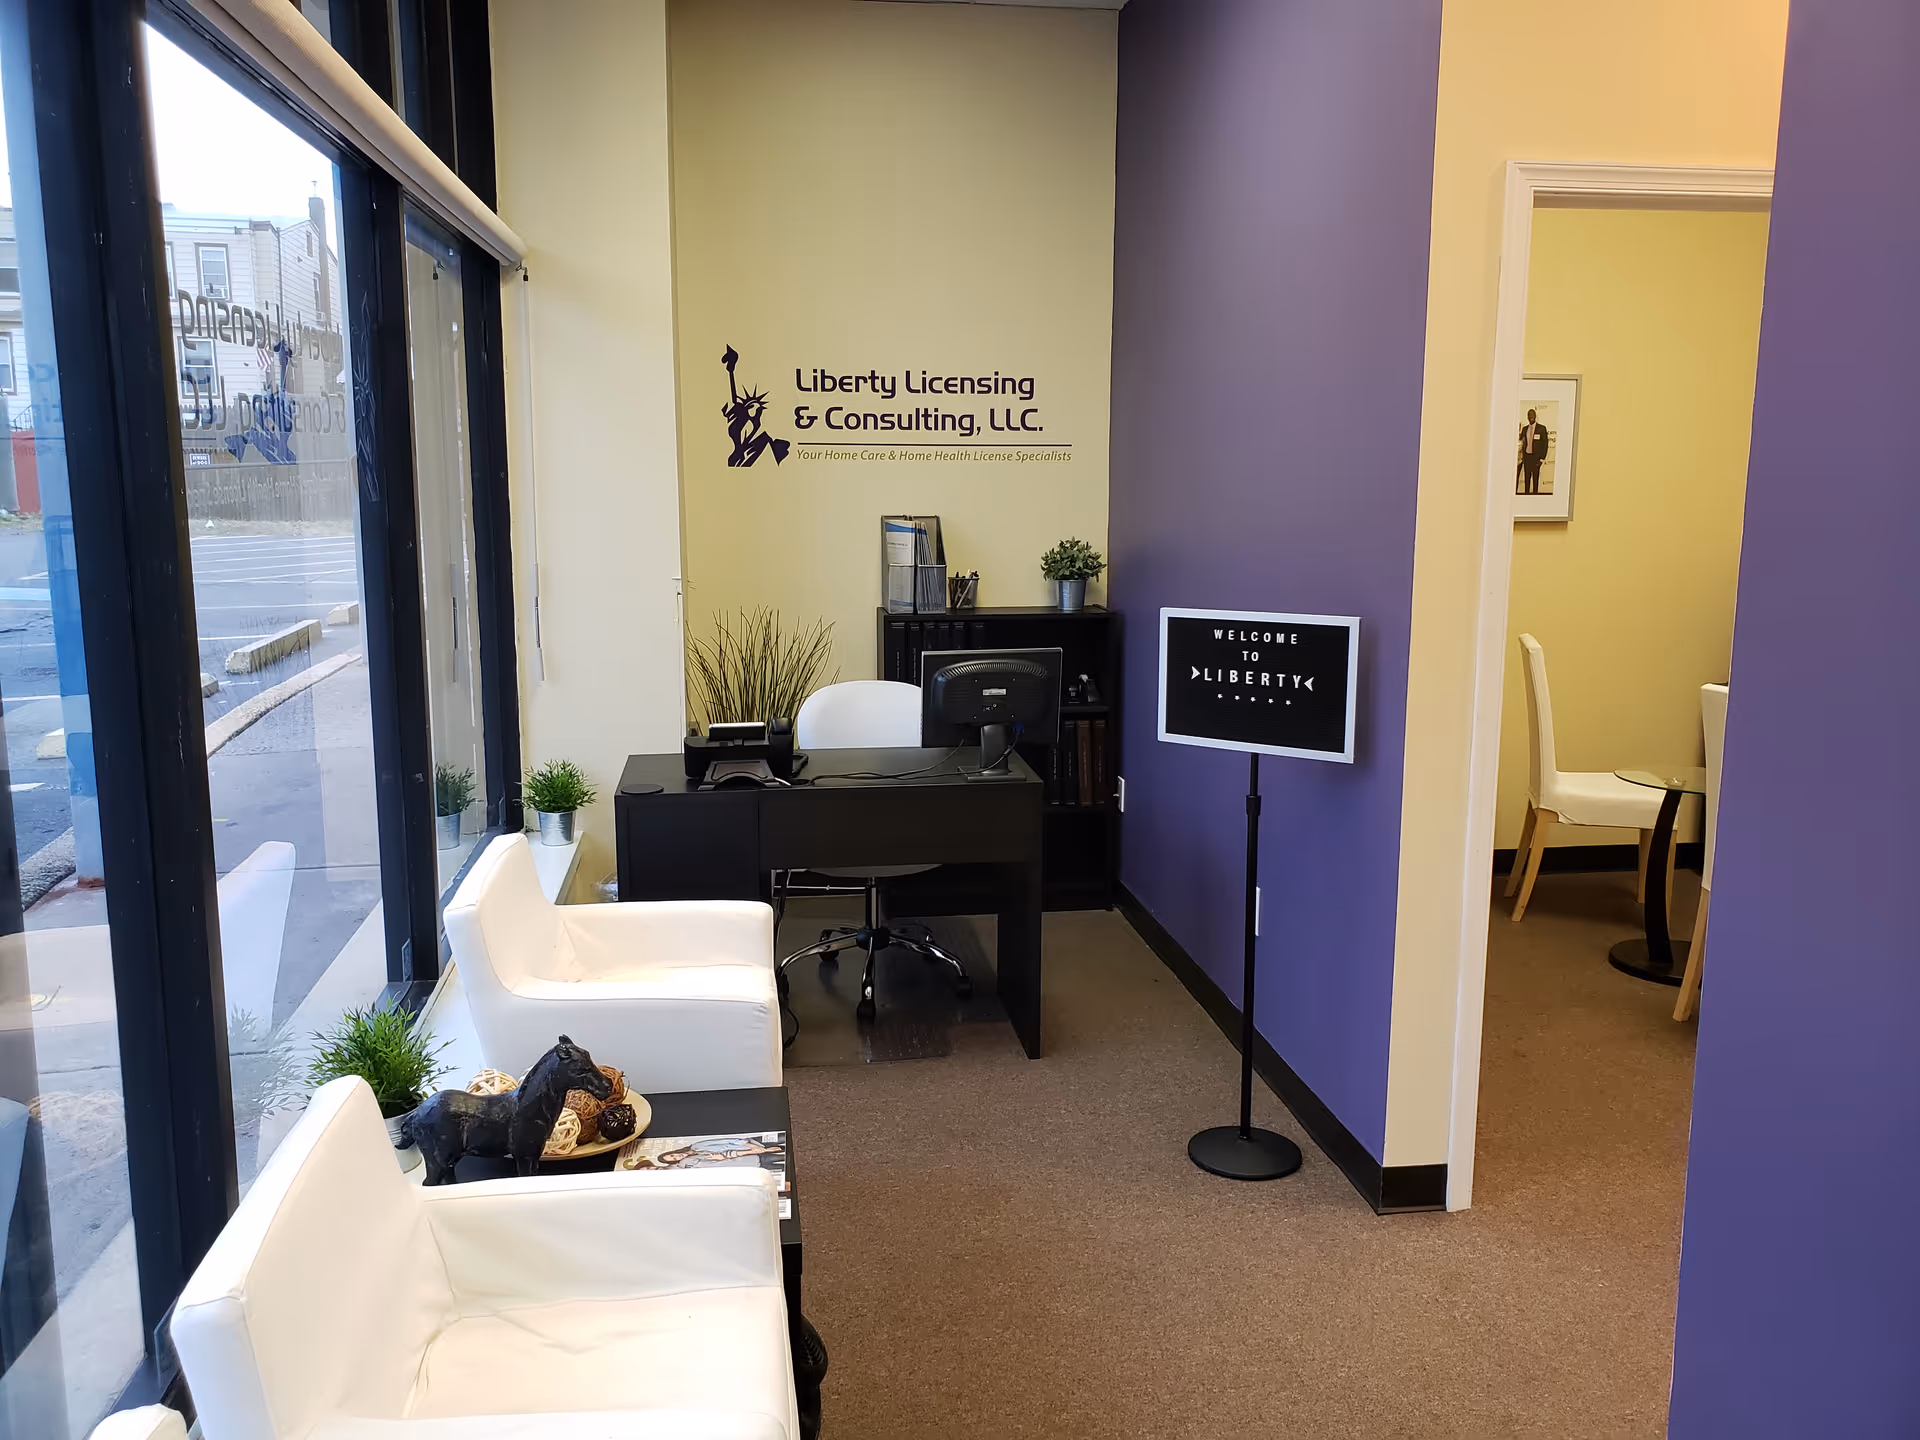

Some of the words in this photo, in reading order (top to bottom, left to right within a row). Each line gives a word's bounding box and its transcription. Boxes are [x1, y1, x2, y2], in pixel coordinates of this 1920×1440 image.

[796, 369, 896, 399] Liberty
[906, 370, 1034, 400] Licensing
[794, 406, 818, 429] &
[825, 407, 981, 437] Consulting,
[990, 408, 1043, 431] LLC.
[797, 450, 822, 460] Your
[825, 450, 857, 460] Home
[861, 450, 886, 460] Care
[888, 450, 896, 460] &
[899, 450, 932, 460] Home
[934, 450, 970, 461] Health
[974, 451, 1012, 462] License
[1015, 451, 1072, 463] Specialists
[1214, 629, 1297, 644] WELCOME
[1242, 651, 1259, 661] TO
[1205, 668, 1301, 688] LIBERTY
